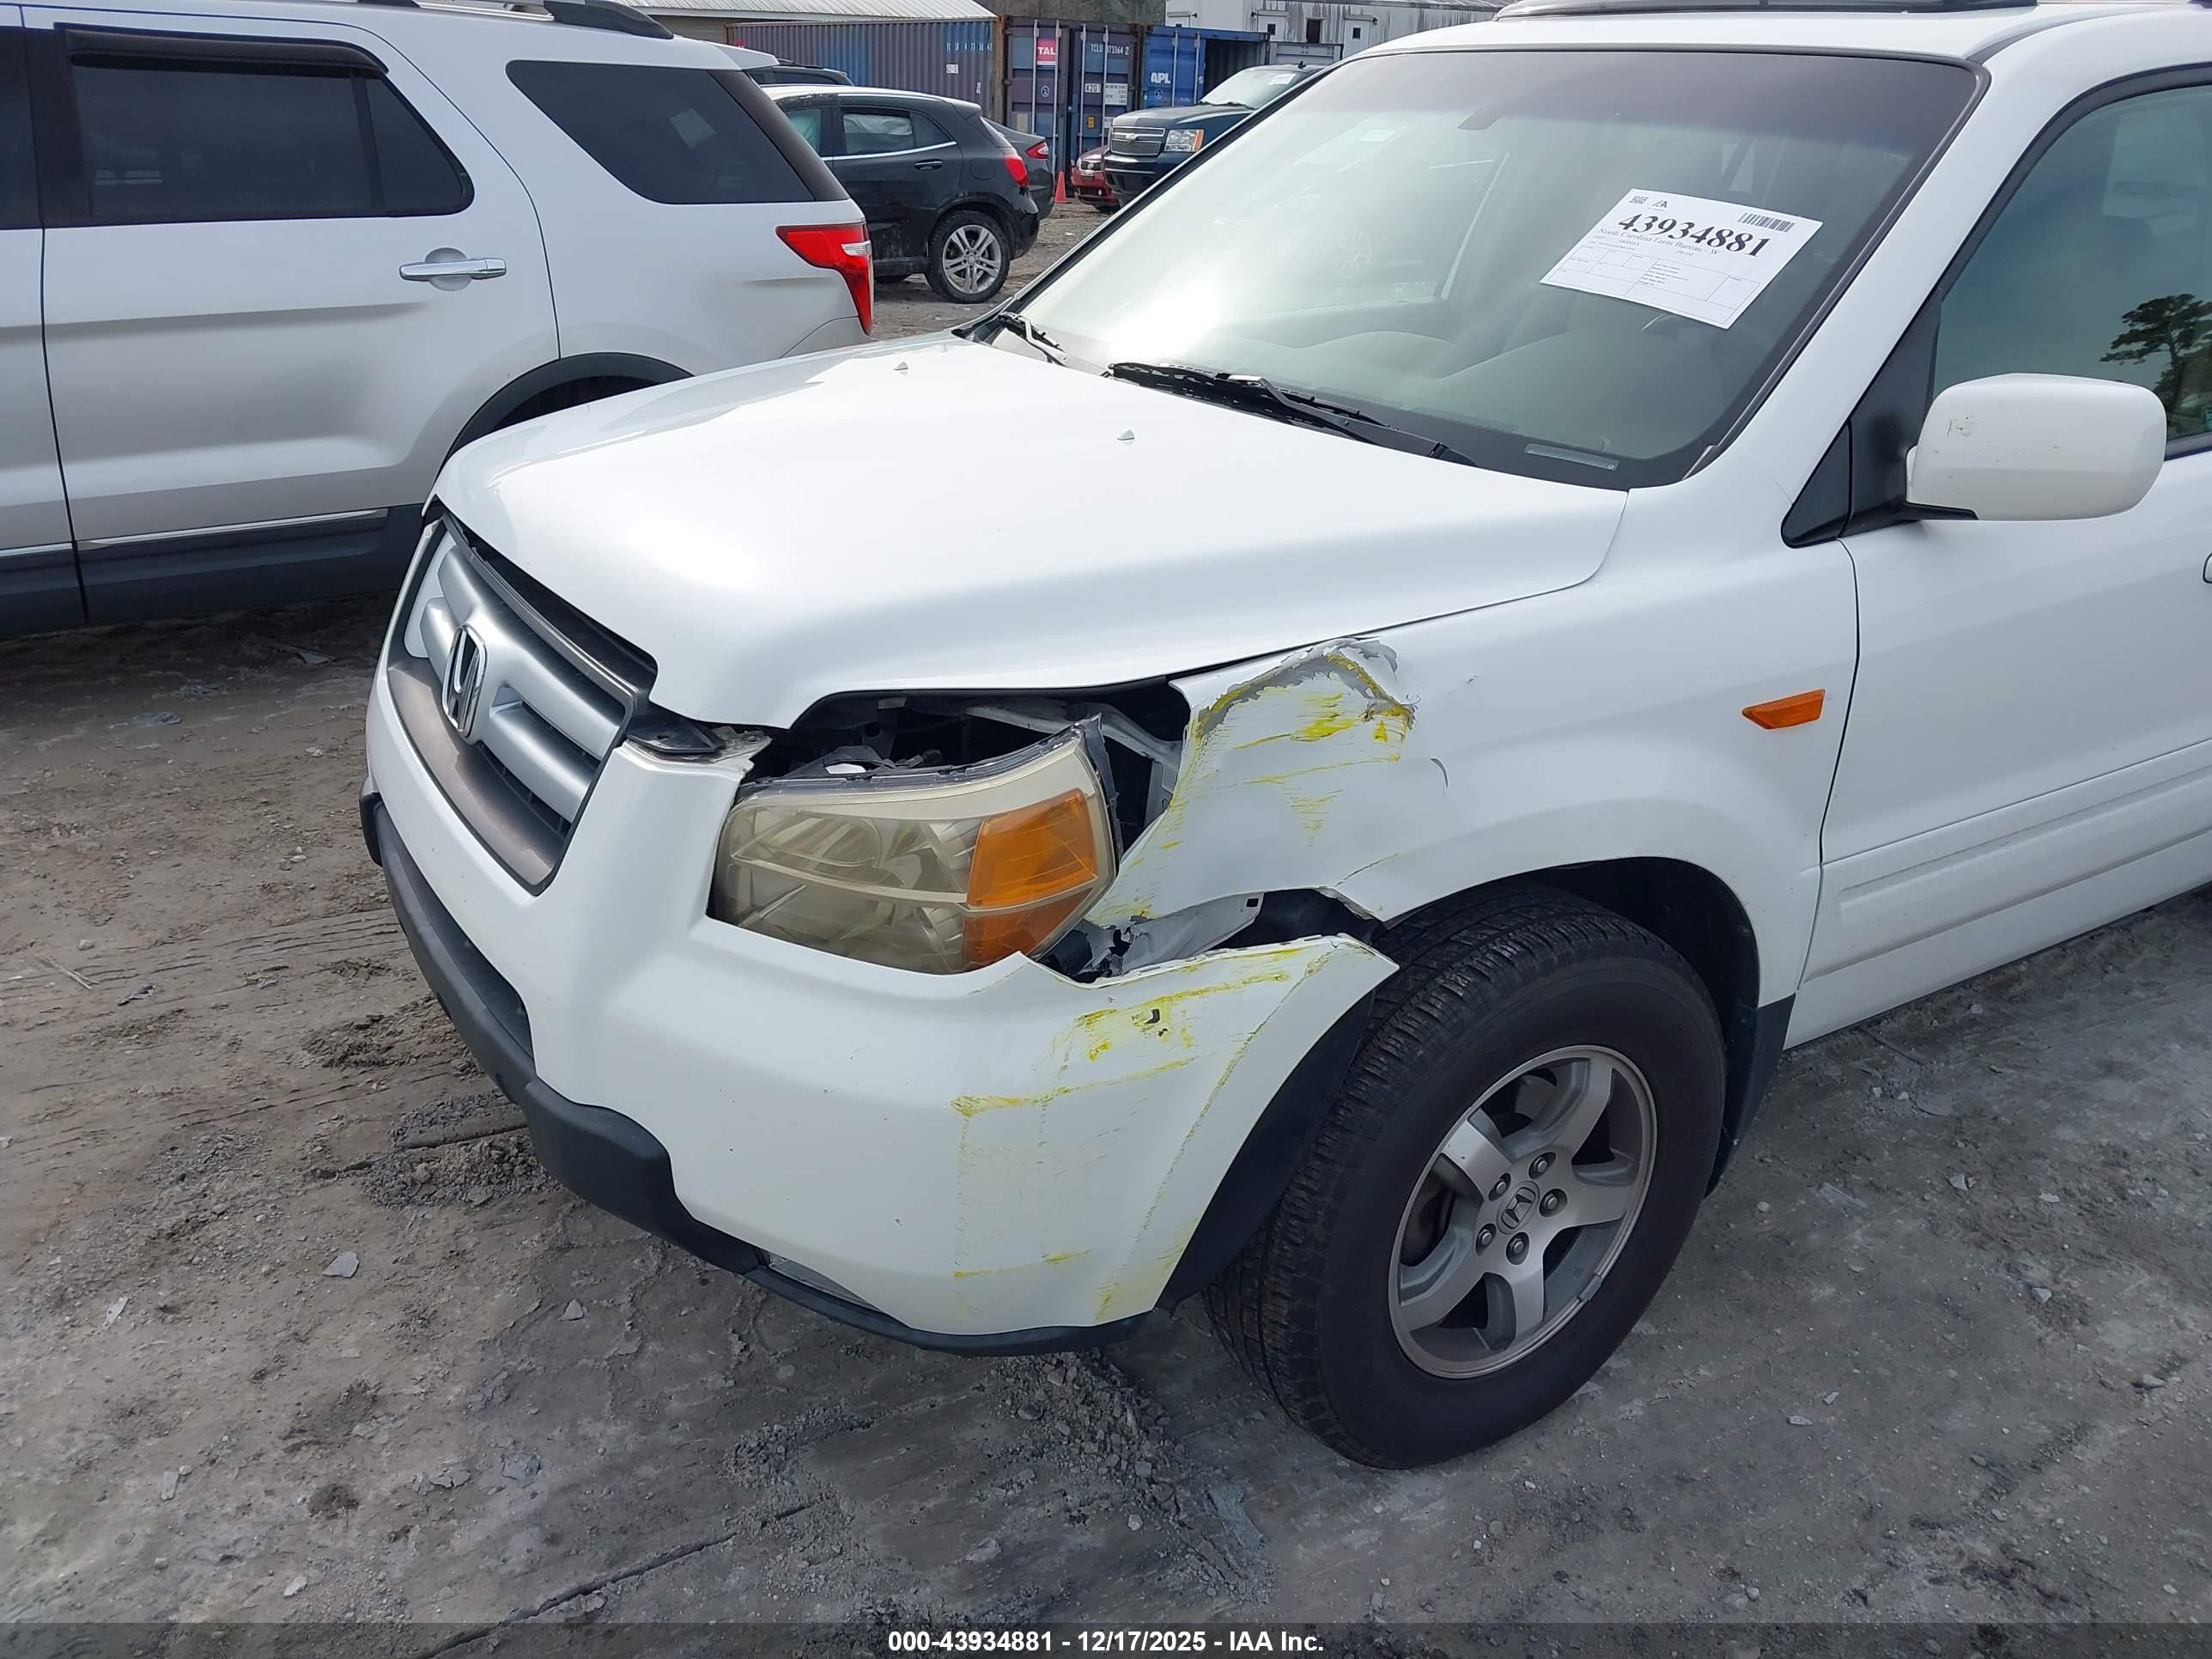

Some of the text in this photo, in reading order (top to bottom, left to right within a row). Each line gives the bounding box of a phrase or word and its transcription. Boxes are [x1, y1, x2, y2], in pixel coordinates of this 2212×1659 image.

[1037, 46, 1056, 56] TAL
[1151, 72, 1171, 84] APL
[1596, 228, 1620, 236] North
[1620, 232, 1652, 242] Carolina
[1654, 237, 1674, 246] Farm
[1674, 241, 1704, 252] Bureau
[1618, 214, 1771, 258] 43934881
